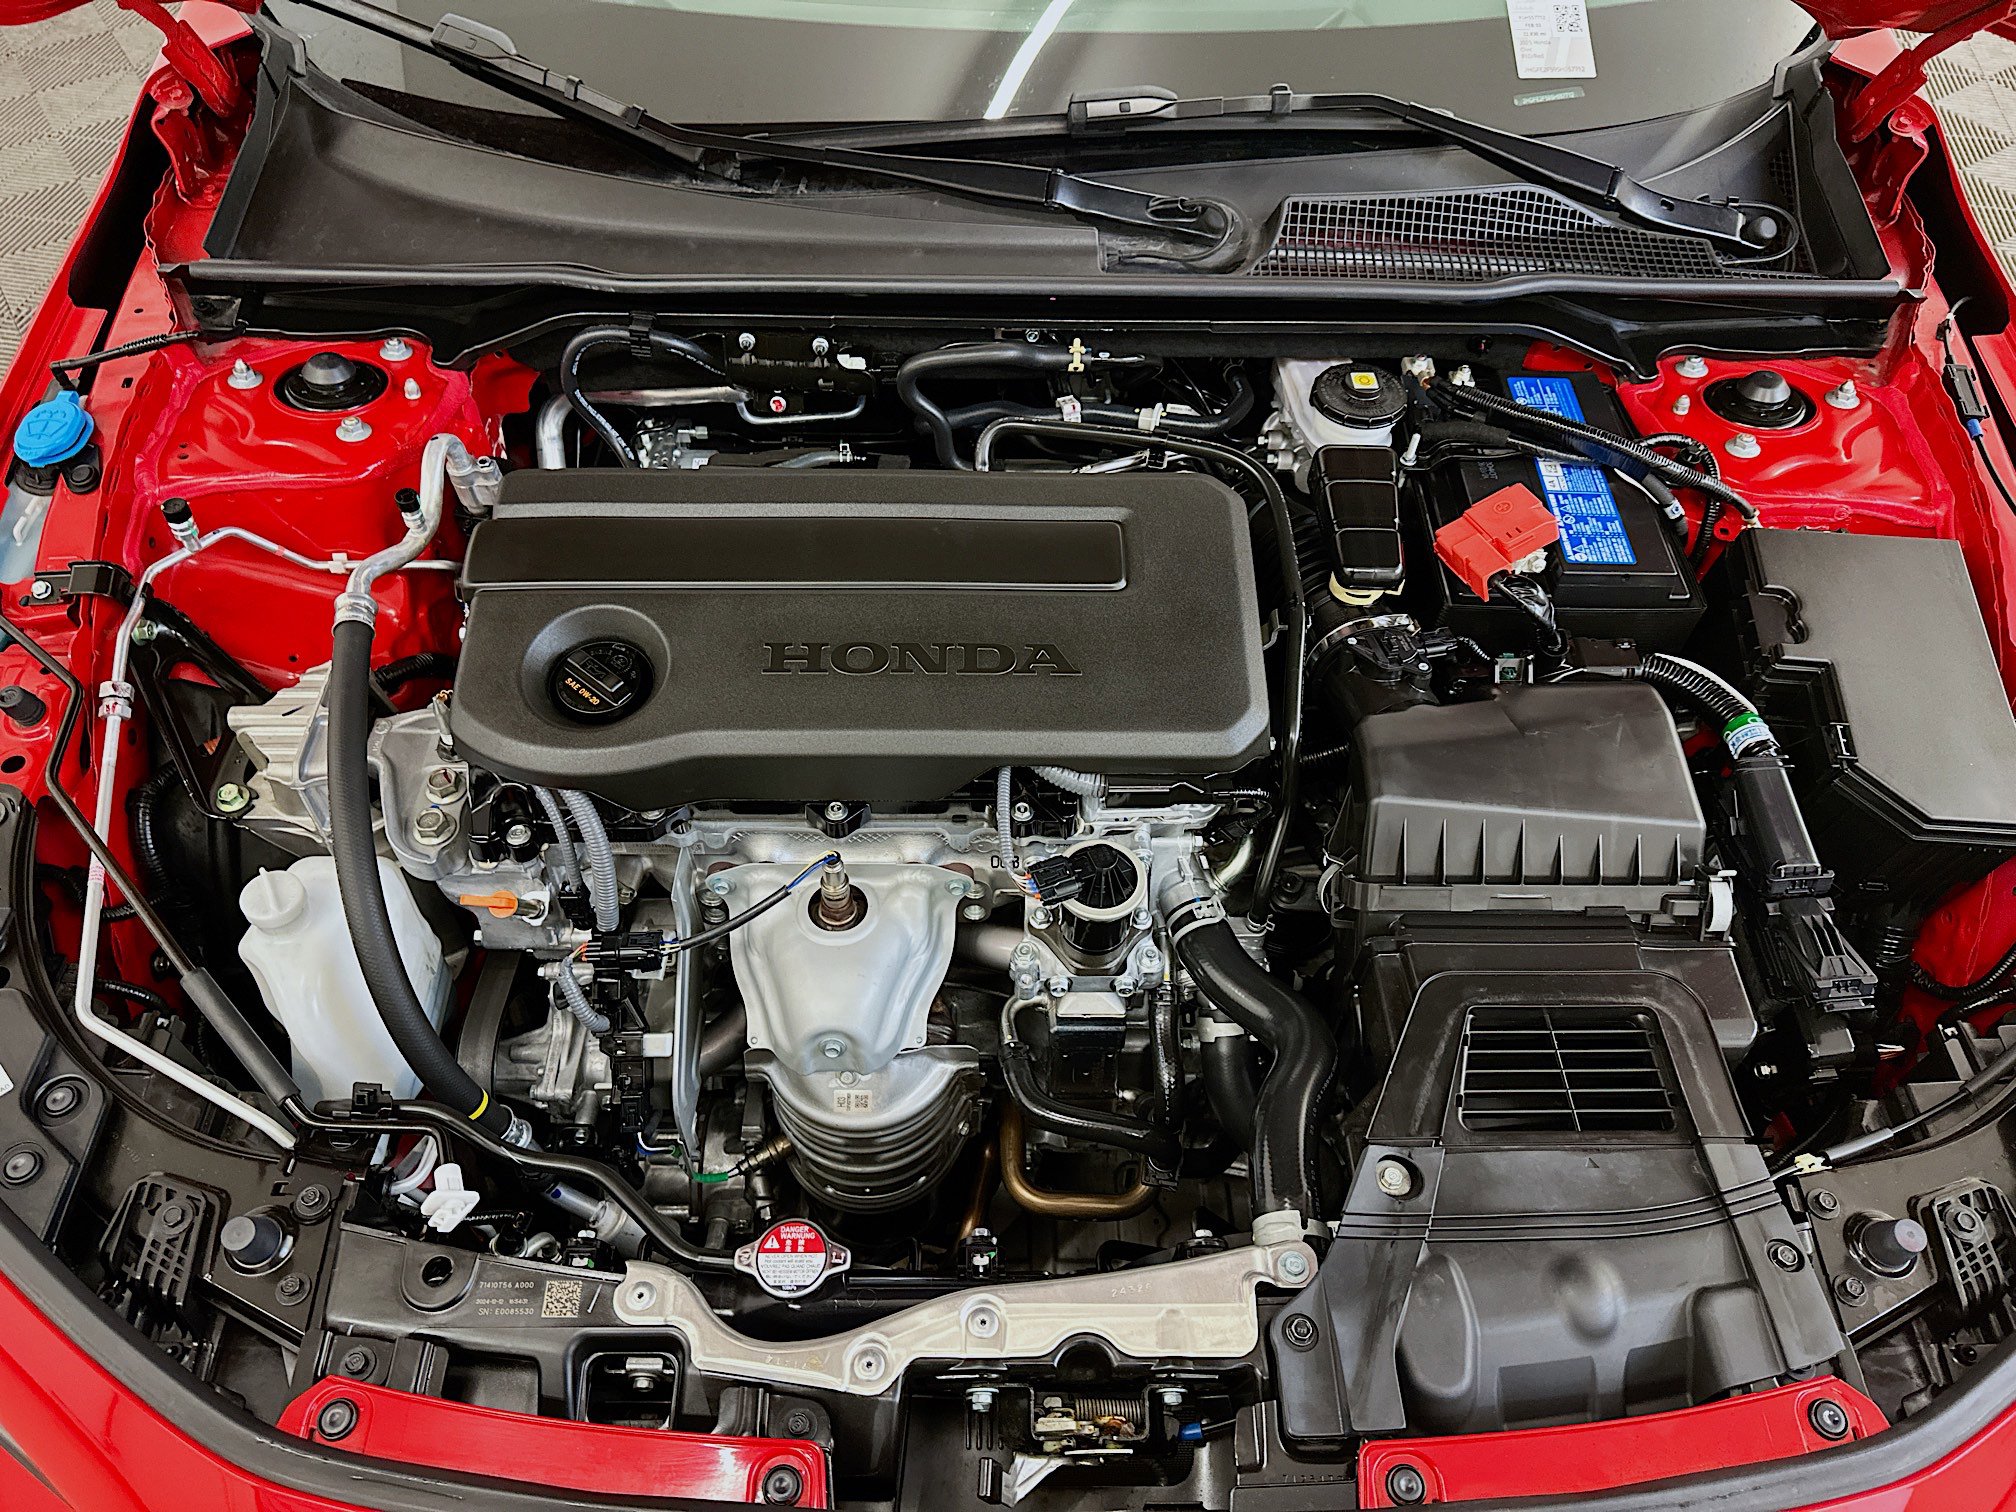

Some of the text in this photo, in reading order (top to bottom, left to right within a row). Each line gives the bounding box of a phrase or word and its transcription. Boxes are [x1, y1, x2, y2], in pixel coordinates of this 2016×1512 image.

[761, 642, 1083, 676] HONDA
[564, 677, 600, 706] SAE 0W-20
[480, 1281, 535, 1289] 71410T56 A000
[478, 1308, 493, 1316] SN:
